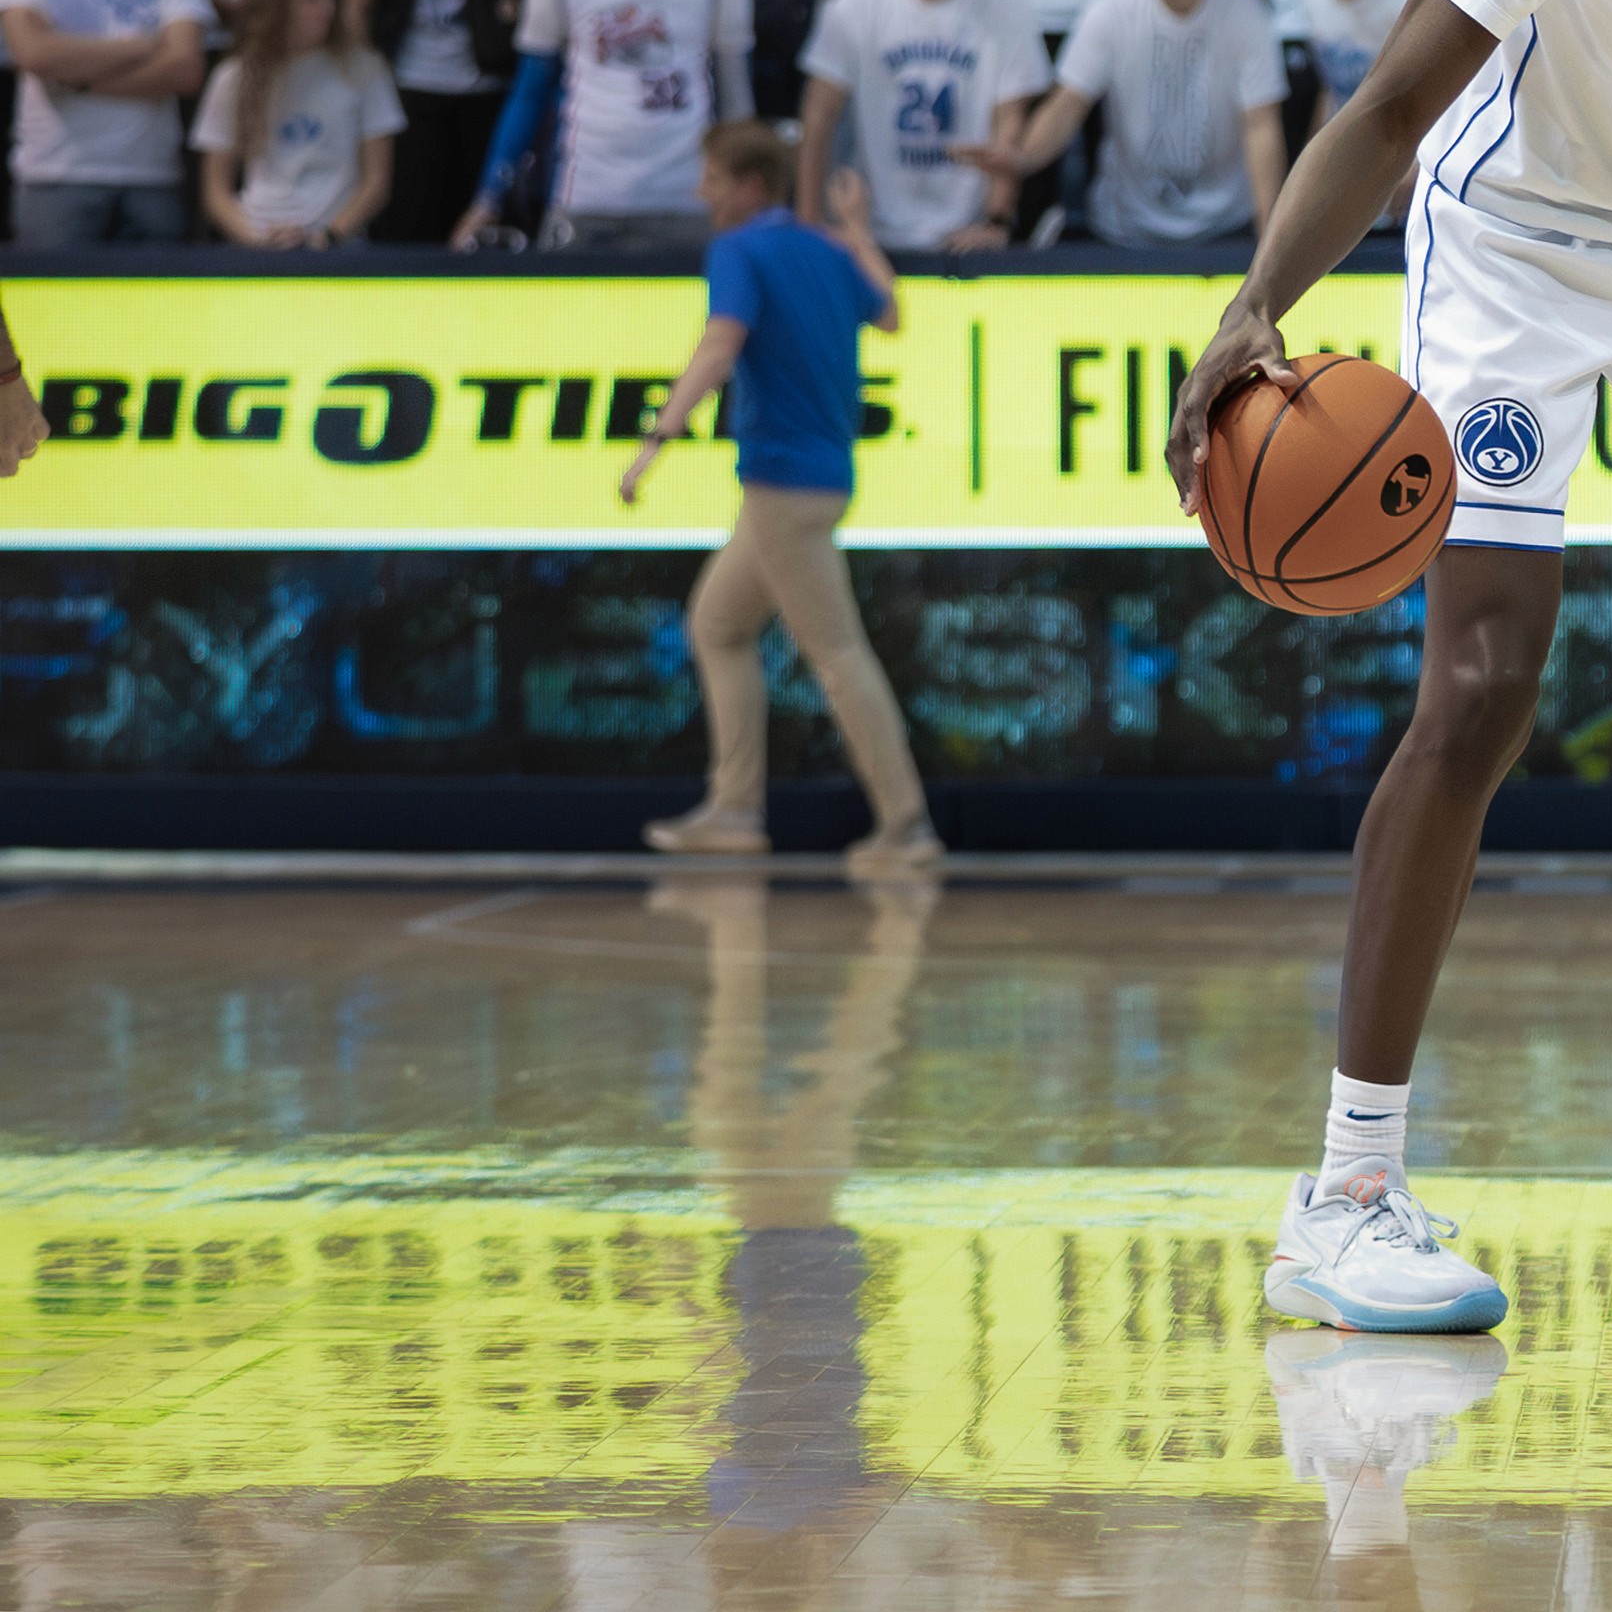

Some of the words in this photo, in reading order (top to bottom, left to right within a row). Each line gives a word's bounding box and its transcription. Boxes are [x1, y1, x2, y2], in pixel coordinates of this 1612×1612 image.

[897, 80, 955, 134] 24
[41, 378, 290, 442] BIG
[1485, 449, 1513, 471] Y
[1390, 461, 1431, 514] Y
